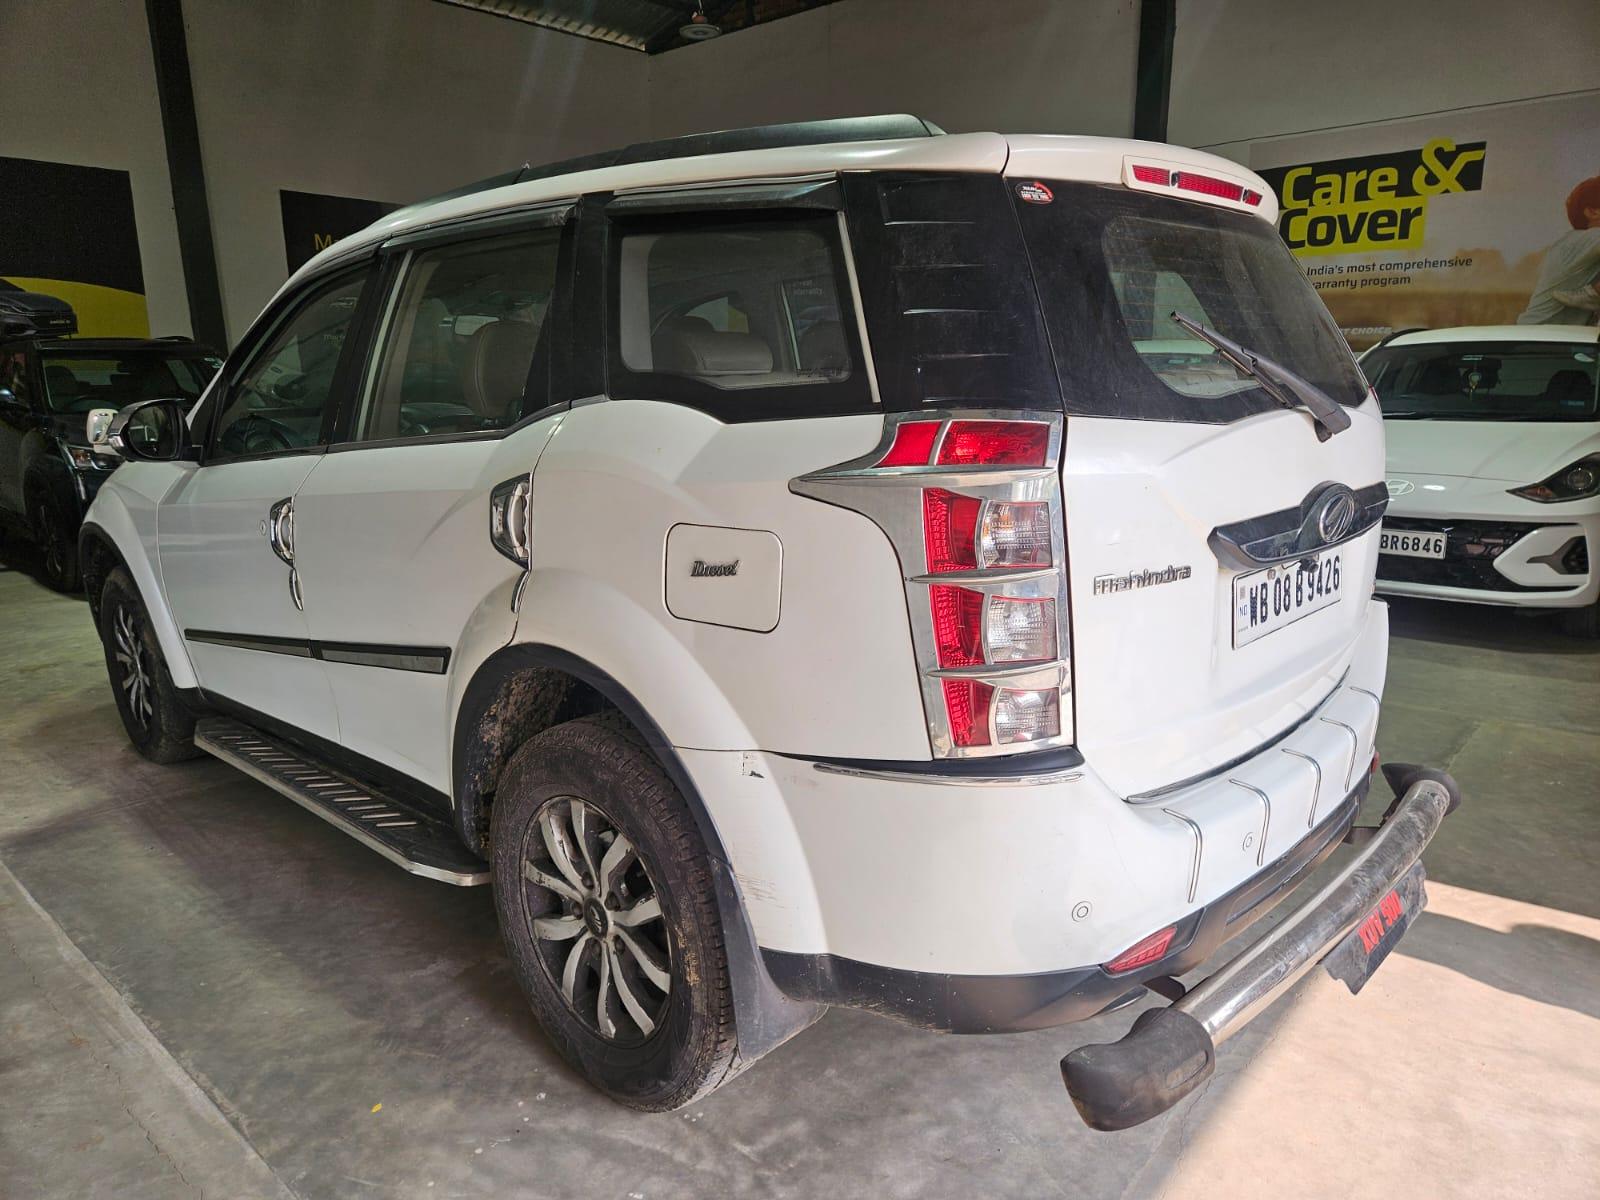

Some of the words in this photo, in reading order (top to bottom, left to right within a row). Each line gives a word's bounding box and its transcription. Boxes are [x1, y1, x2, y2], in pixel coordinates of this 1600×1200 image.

[1282, 166, 1398, 209] Care
[1412, 137, 1485, 195] &
[1279, 205, 1423, 250] Cover
[1306, 264, 1344, 277] India's
[1346, 261, 1376, 274] most
[1379, 256, 1473, 273] comprehensive
[1360, 275, 1411, 289] program
[1380, 534, 1443, 554] BR6846
[1250, 582, 1268, 627] WB
[1274, 573, 1291, 616] 08
[1295, 568, 1304, 607] B
[1307, 556, 1339, 601] 9426
